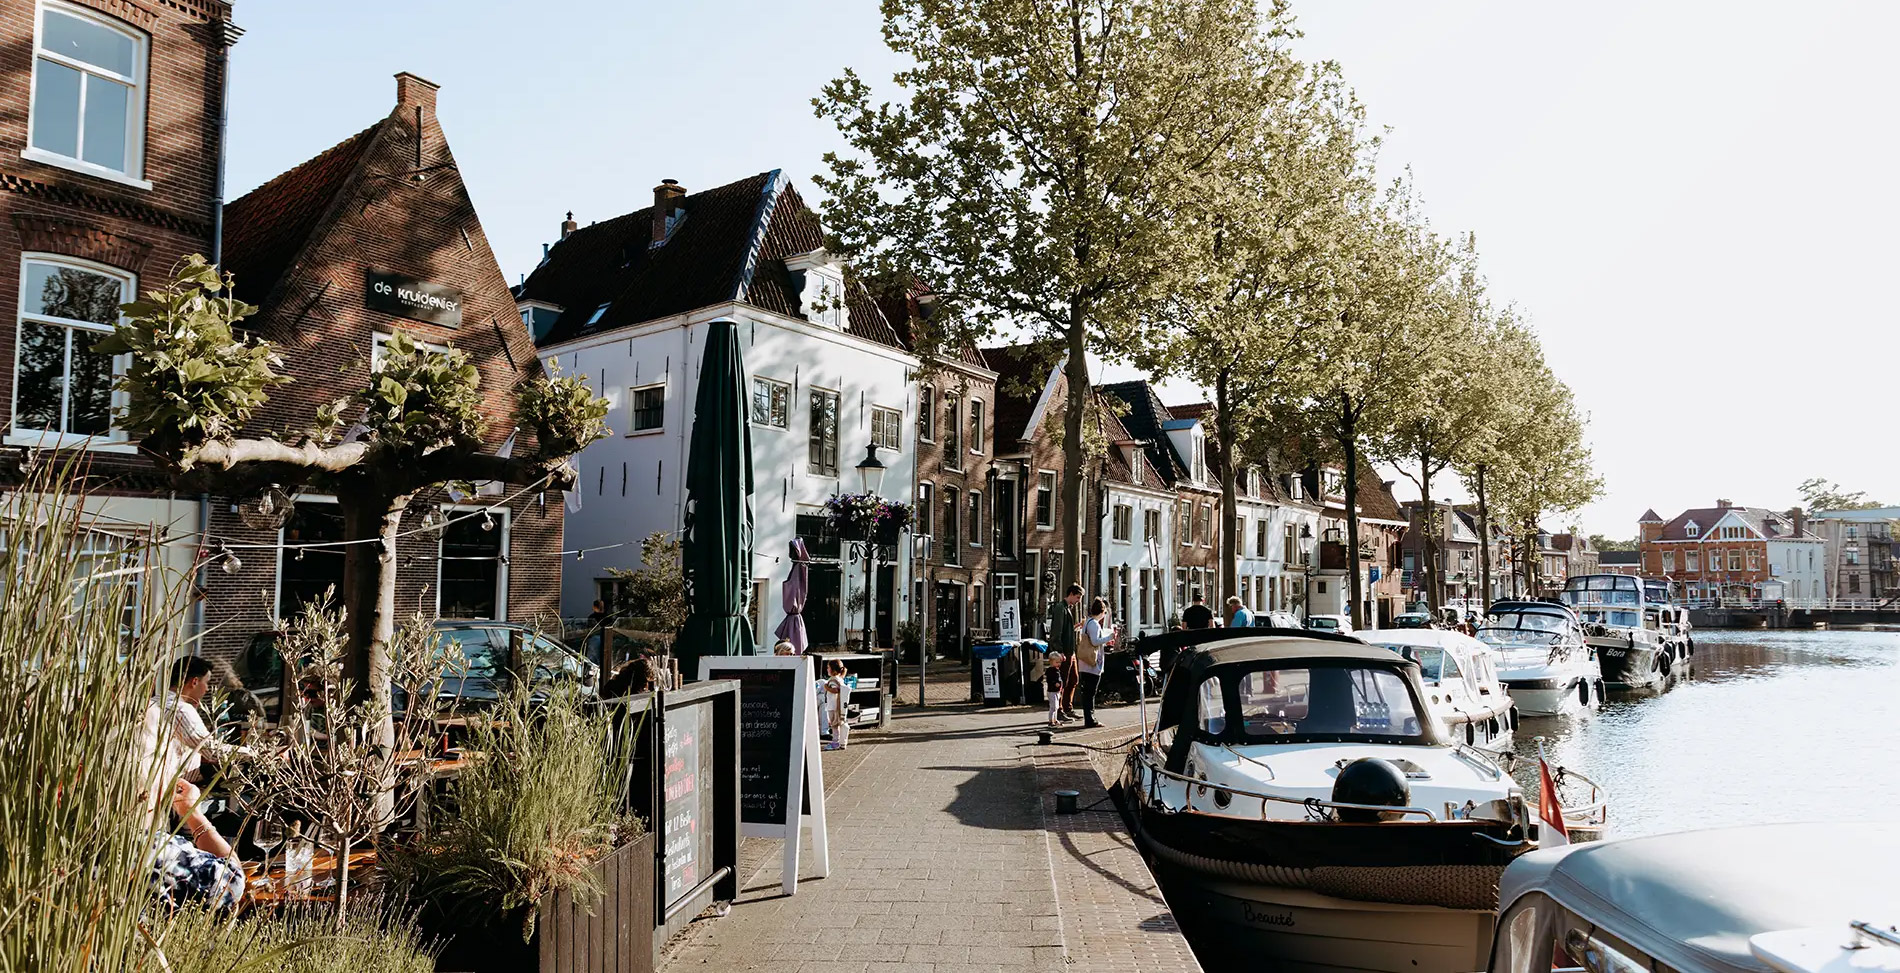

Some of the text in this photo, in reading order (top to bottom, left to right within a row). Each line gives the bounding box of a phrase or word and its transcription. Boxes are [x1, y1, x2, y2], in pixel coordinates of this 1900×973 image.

[374, 281, 393, 296] de
[1606, 648, 1626, 658] Bora
[1240, 901, 1295, 927] Beauté
